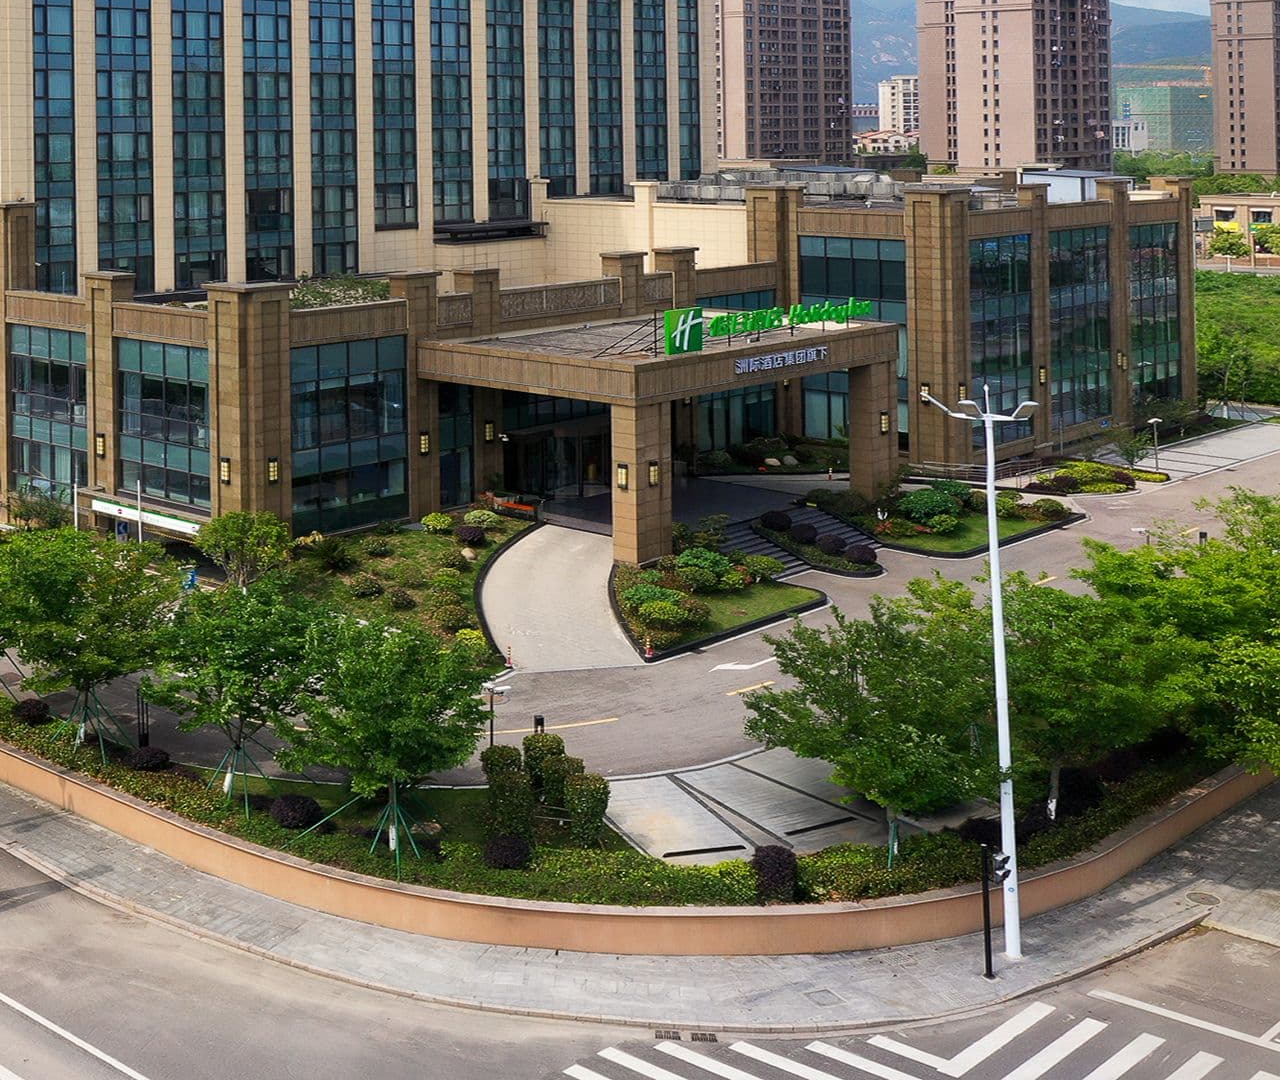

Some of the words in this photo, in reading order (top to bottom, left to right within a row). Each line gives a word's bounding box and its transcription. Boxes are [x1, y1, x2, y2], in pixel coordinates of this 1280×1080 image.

[707, 307, 785, 337] 假日酒店
[788, 300, 849, 325] Holiday
[848, 296, 873, 316] Inn
[734, 346, 829, 374] 洲际酒店集团旗下
